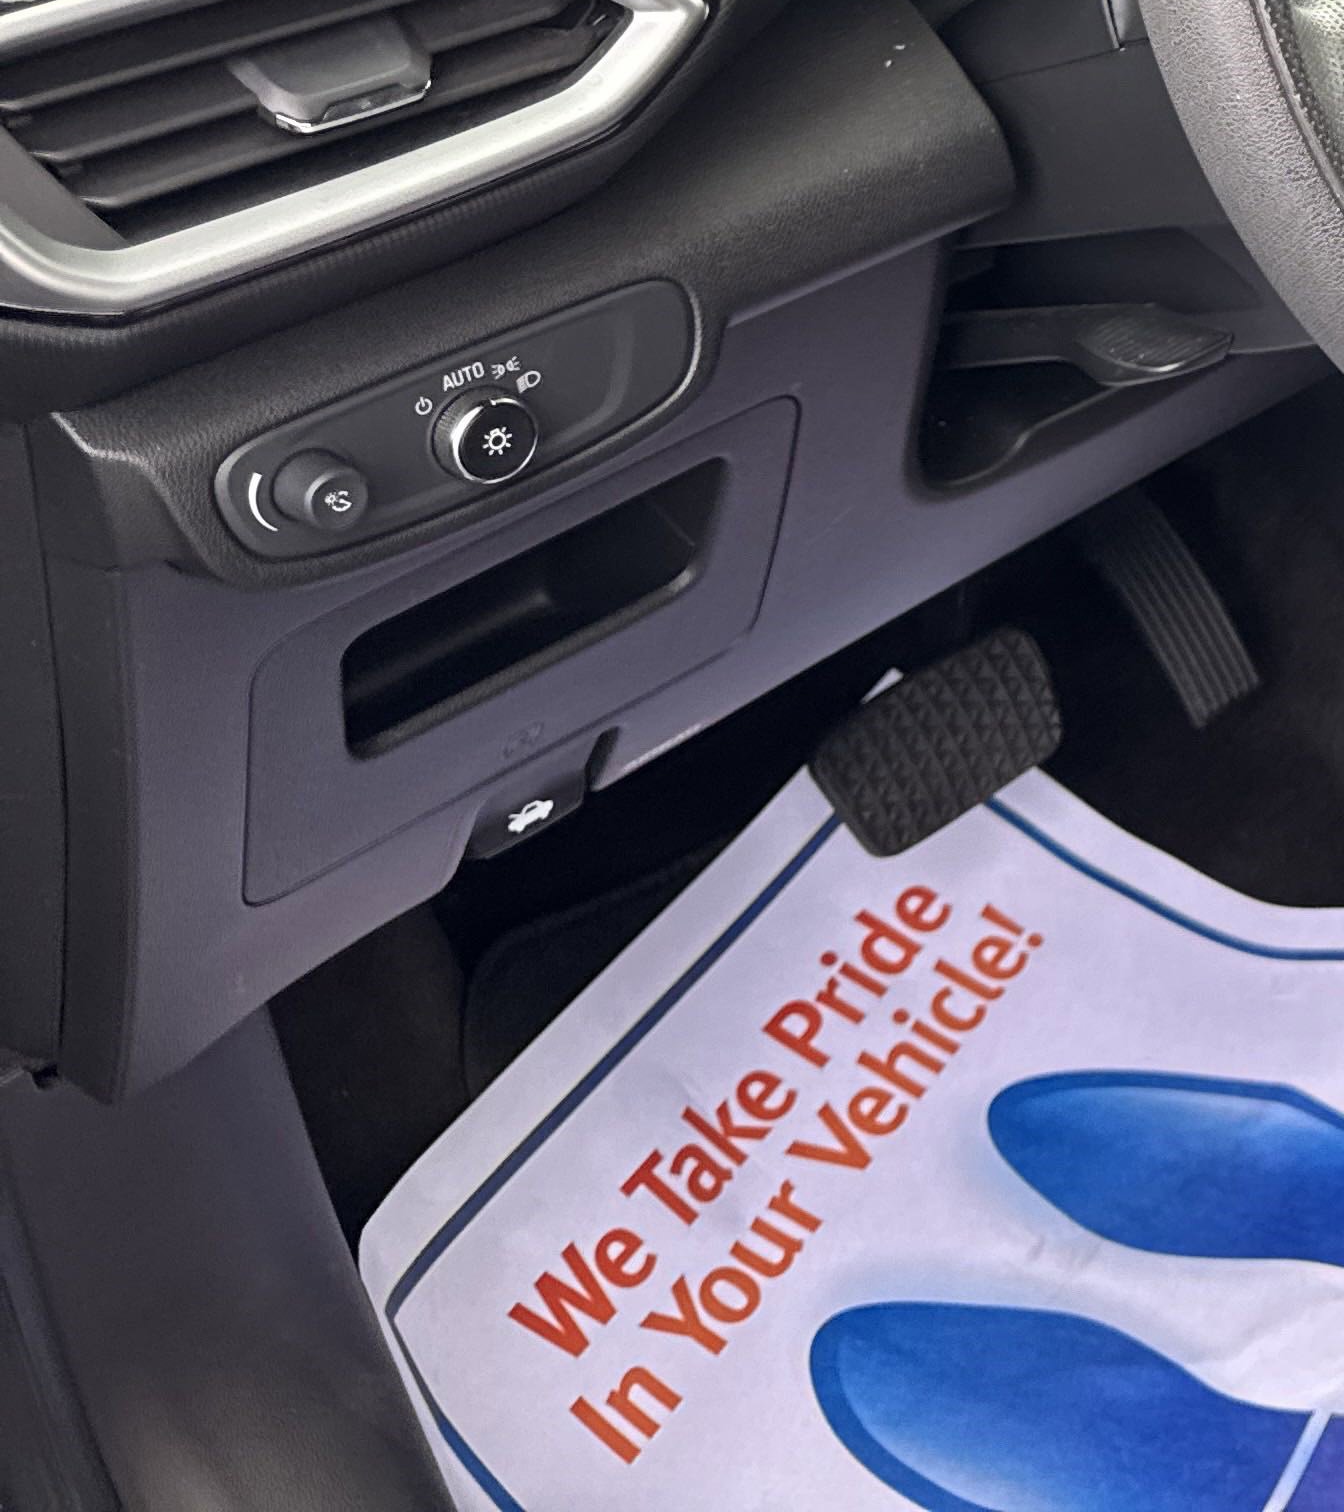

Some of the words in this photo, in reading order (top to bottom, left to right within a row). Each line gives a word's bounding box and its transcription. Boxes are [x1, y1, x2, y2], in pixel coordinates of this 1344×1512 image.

[443, 361, 485, 392] AUTO
[506, 1224, 658, 1358] We
[619, 1069, 799, 1227] Take
[761, 885, 953, 1068] Pride
[568, 1365, 683, 1465] In
[639, 1179, 823, 1357] Your
[785, 903, 1045, 1174] Vehicle!
